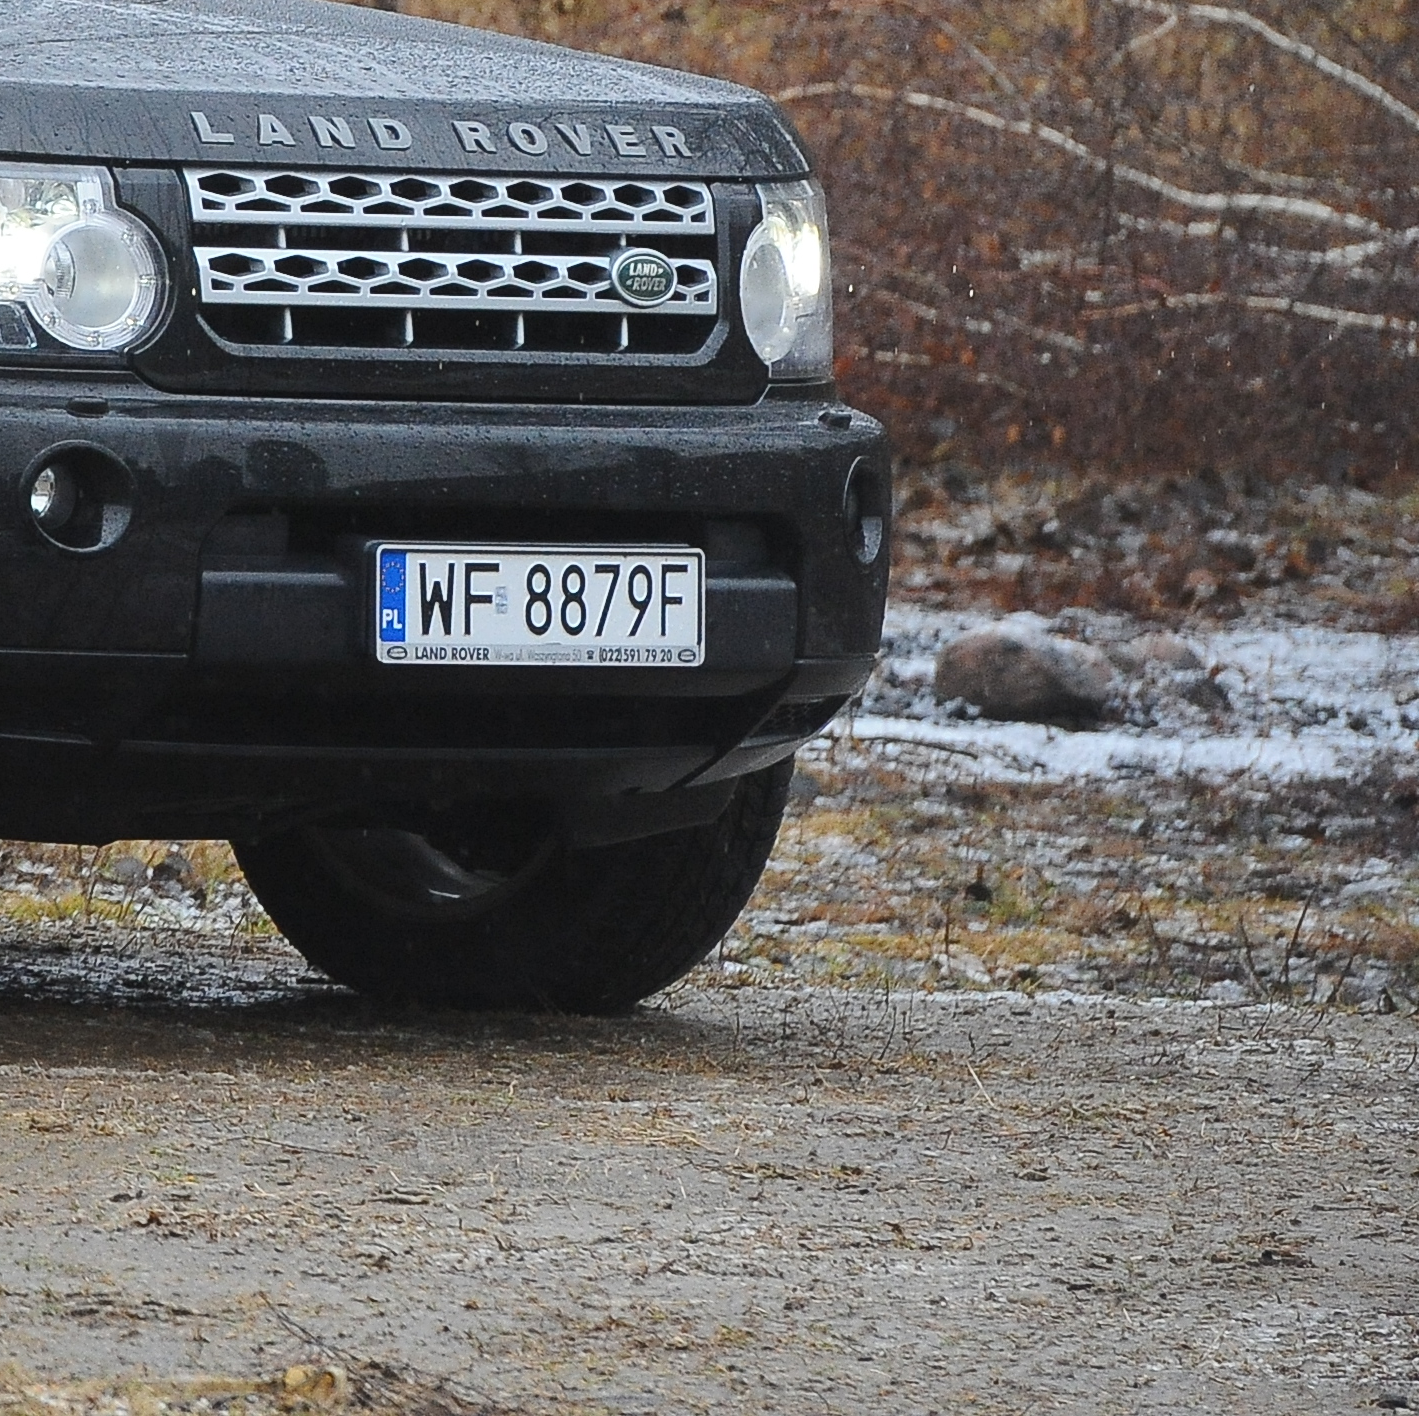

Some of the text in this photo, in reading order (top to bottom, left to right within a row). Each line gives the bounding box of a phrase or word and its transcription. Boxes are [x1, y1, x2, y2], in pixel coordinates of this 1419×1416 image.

[190, 111, 693, 158] LAND ROVER
[628, 262, 658, 277] LAND
[632, 276, 667, 292] ROVER
[419, 562, 500, 636] WF
[525, 563, 689, 637] 8879F
[382, 608, 403, 630] PL
[415, 646, 447, 661] LAND
[451, 647, 490, 661] ROVER
[645, 648, 658, 663] 79
[660, 648, 673, 663] 20
